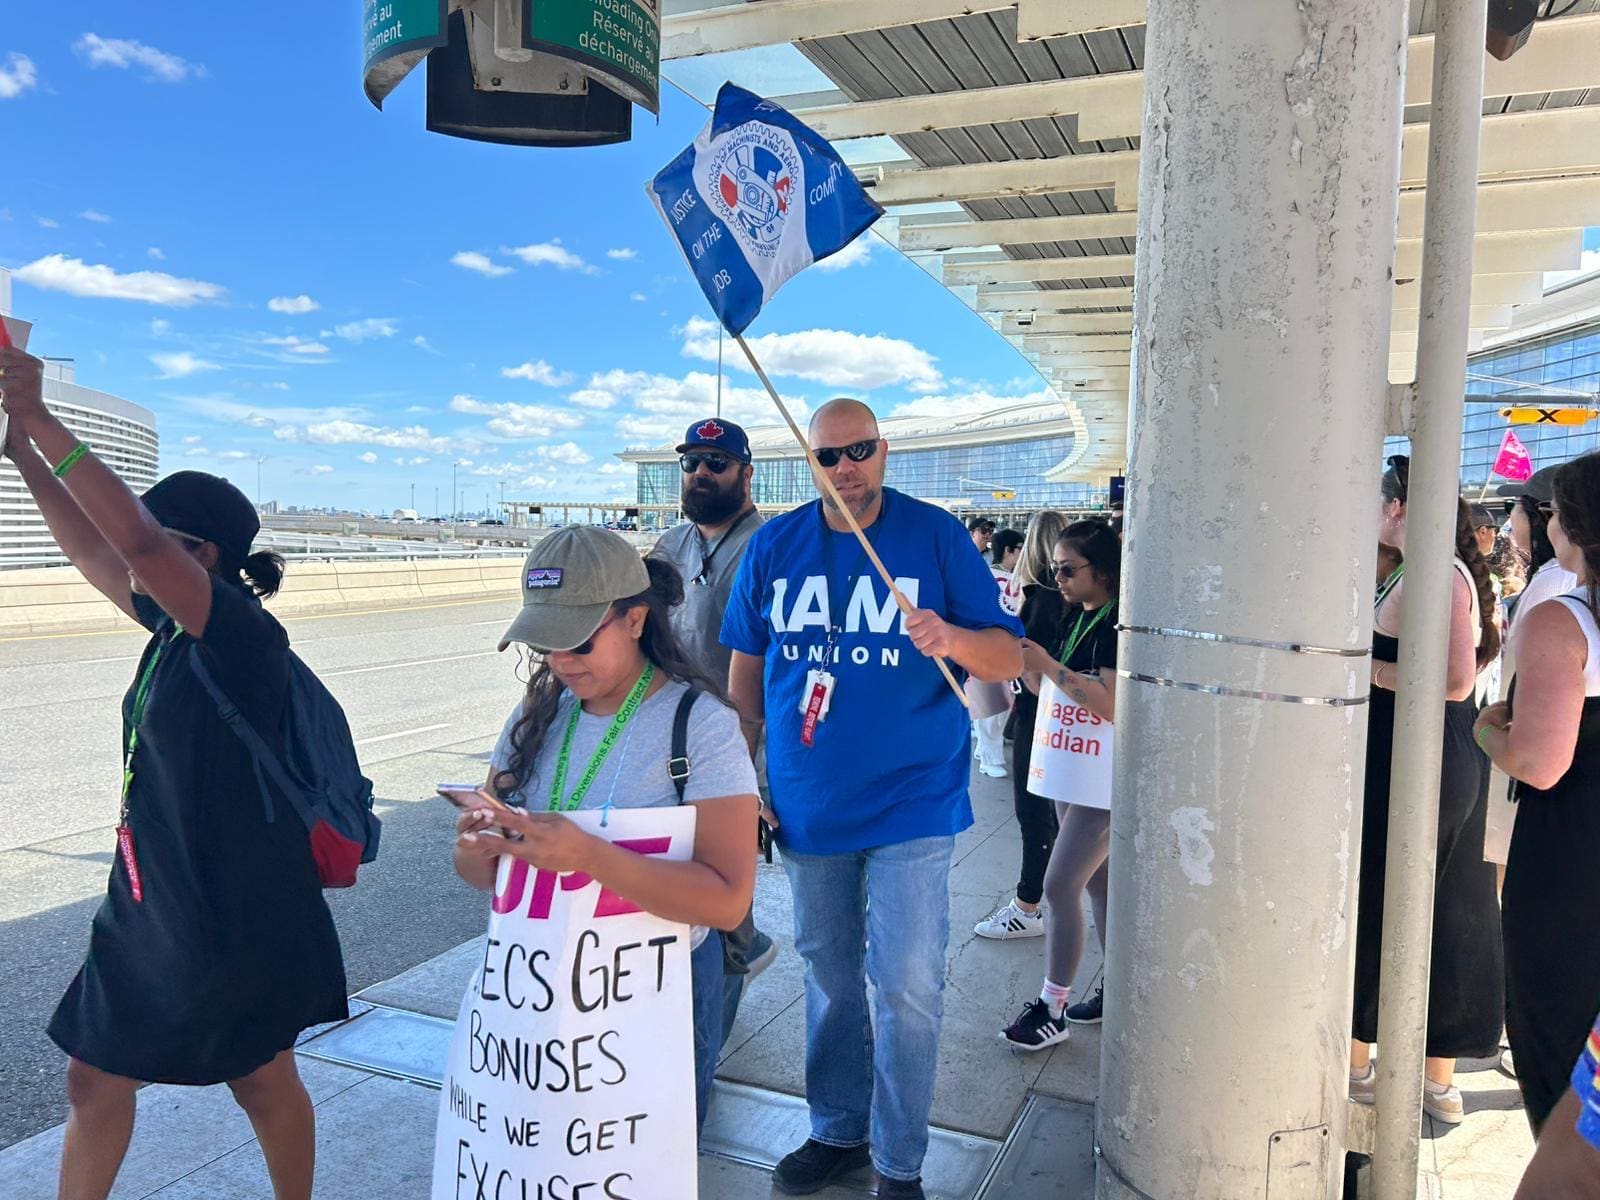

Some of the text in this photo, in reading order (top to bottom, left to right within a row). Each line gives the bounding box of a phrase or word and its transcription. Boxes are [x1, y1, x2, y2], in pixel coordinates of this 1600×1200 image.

[379, 3, 393, 22] au
[593, 10, 644, 53] Réservé
[727, 133, 761, 153] MACHINISTS
[762, 139, 780, 153] AND
[670, 187, 697, 225] JUSTICE
[691, 238, 705, 260] ON
[702, 221, 722, 249] THE
[711, 268, 732, 293] JOB
[770, 575, 920, 636] IAM
[782, 644, 900, 666] UNION
[615, 682, 646, 724] Contract
[1046, 702, 1102, 726] ages
[480, 929, 677, 1014] ECS GET
[470, 1009, 627, 1093] BONUSES
[450, 1075, 649, 1156] WHILE WE GET
